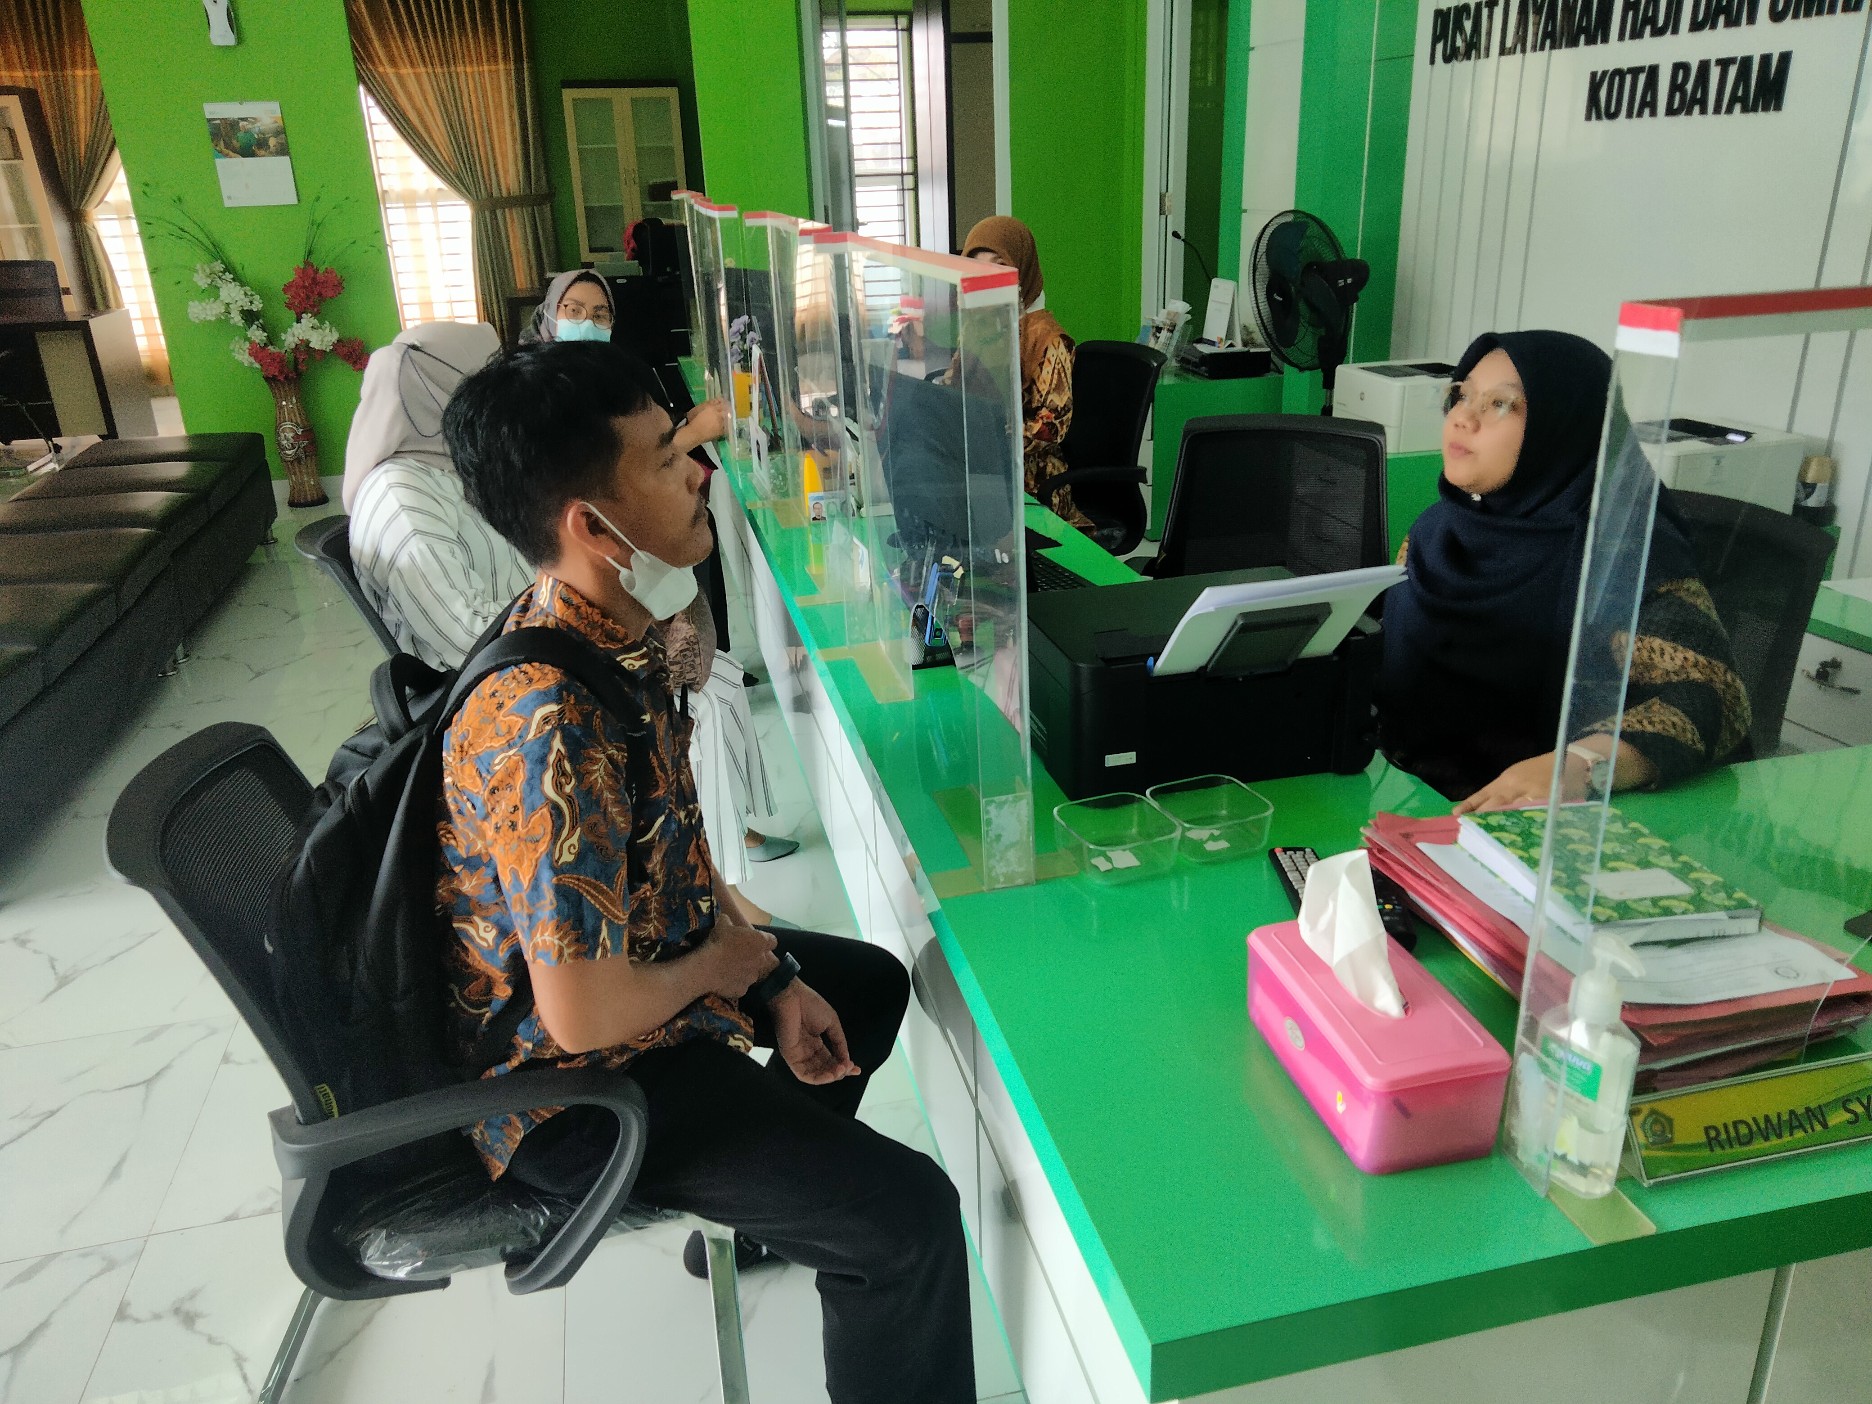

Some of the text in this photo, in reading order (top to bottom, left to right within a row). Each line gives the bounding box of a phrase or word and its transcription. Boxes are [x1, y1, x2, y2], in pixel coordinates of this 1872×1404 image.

[1429, 0, 1499, 66] PUSAT
[1499, 0, 1615, 57] LAYANAN
[1617, 0, 1681, 41] HAJI
[1584, 50, 1794, 121] KOTA BATAM
[1703, 1104, 1829, 1153] RIDWAN
